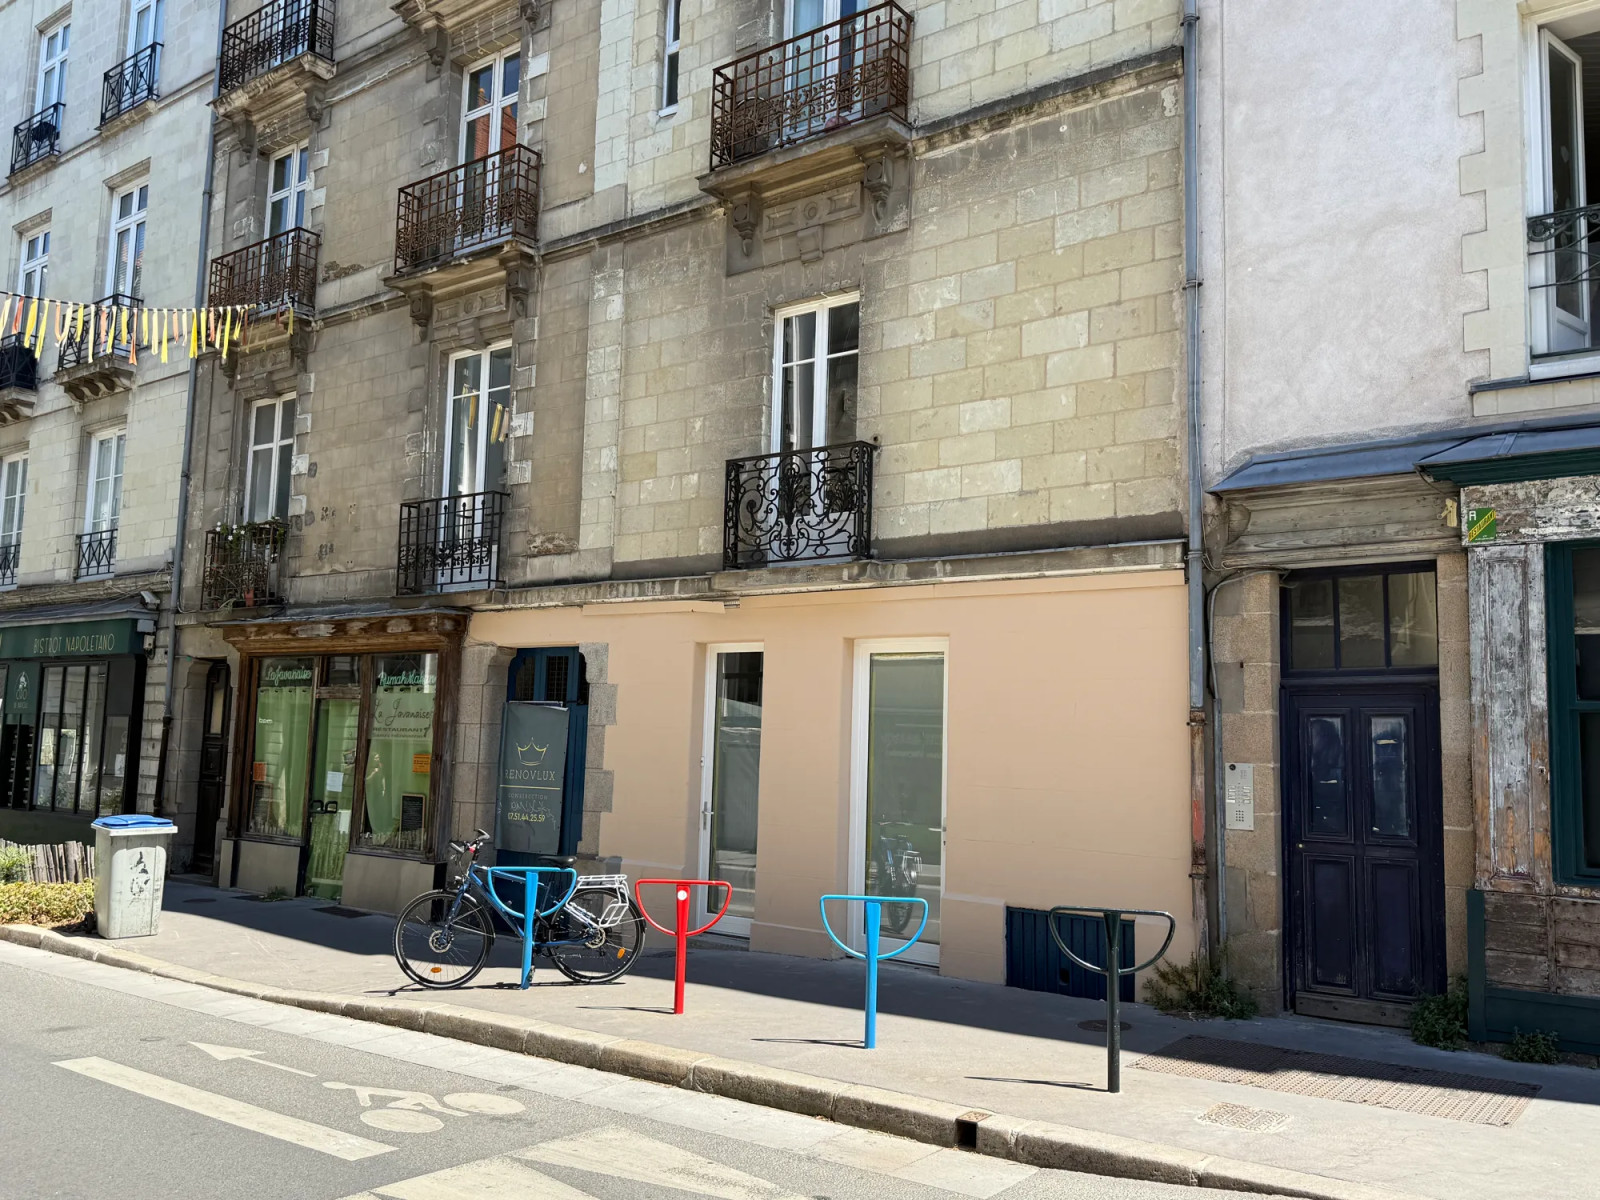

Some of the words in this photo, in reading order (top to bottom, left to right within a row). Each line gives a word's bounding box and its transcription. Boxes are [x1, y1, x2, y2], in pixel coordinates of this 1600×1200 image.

[1469, 510, 1476, 521] A
[33, 637, 62, 654] BISTROT
[65, 633, 115, 652] NAPOLETANO
[385, 698, 431, 726] Javanaise
[505, 769, 556, 781] RENOVLUX
